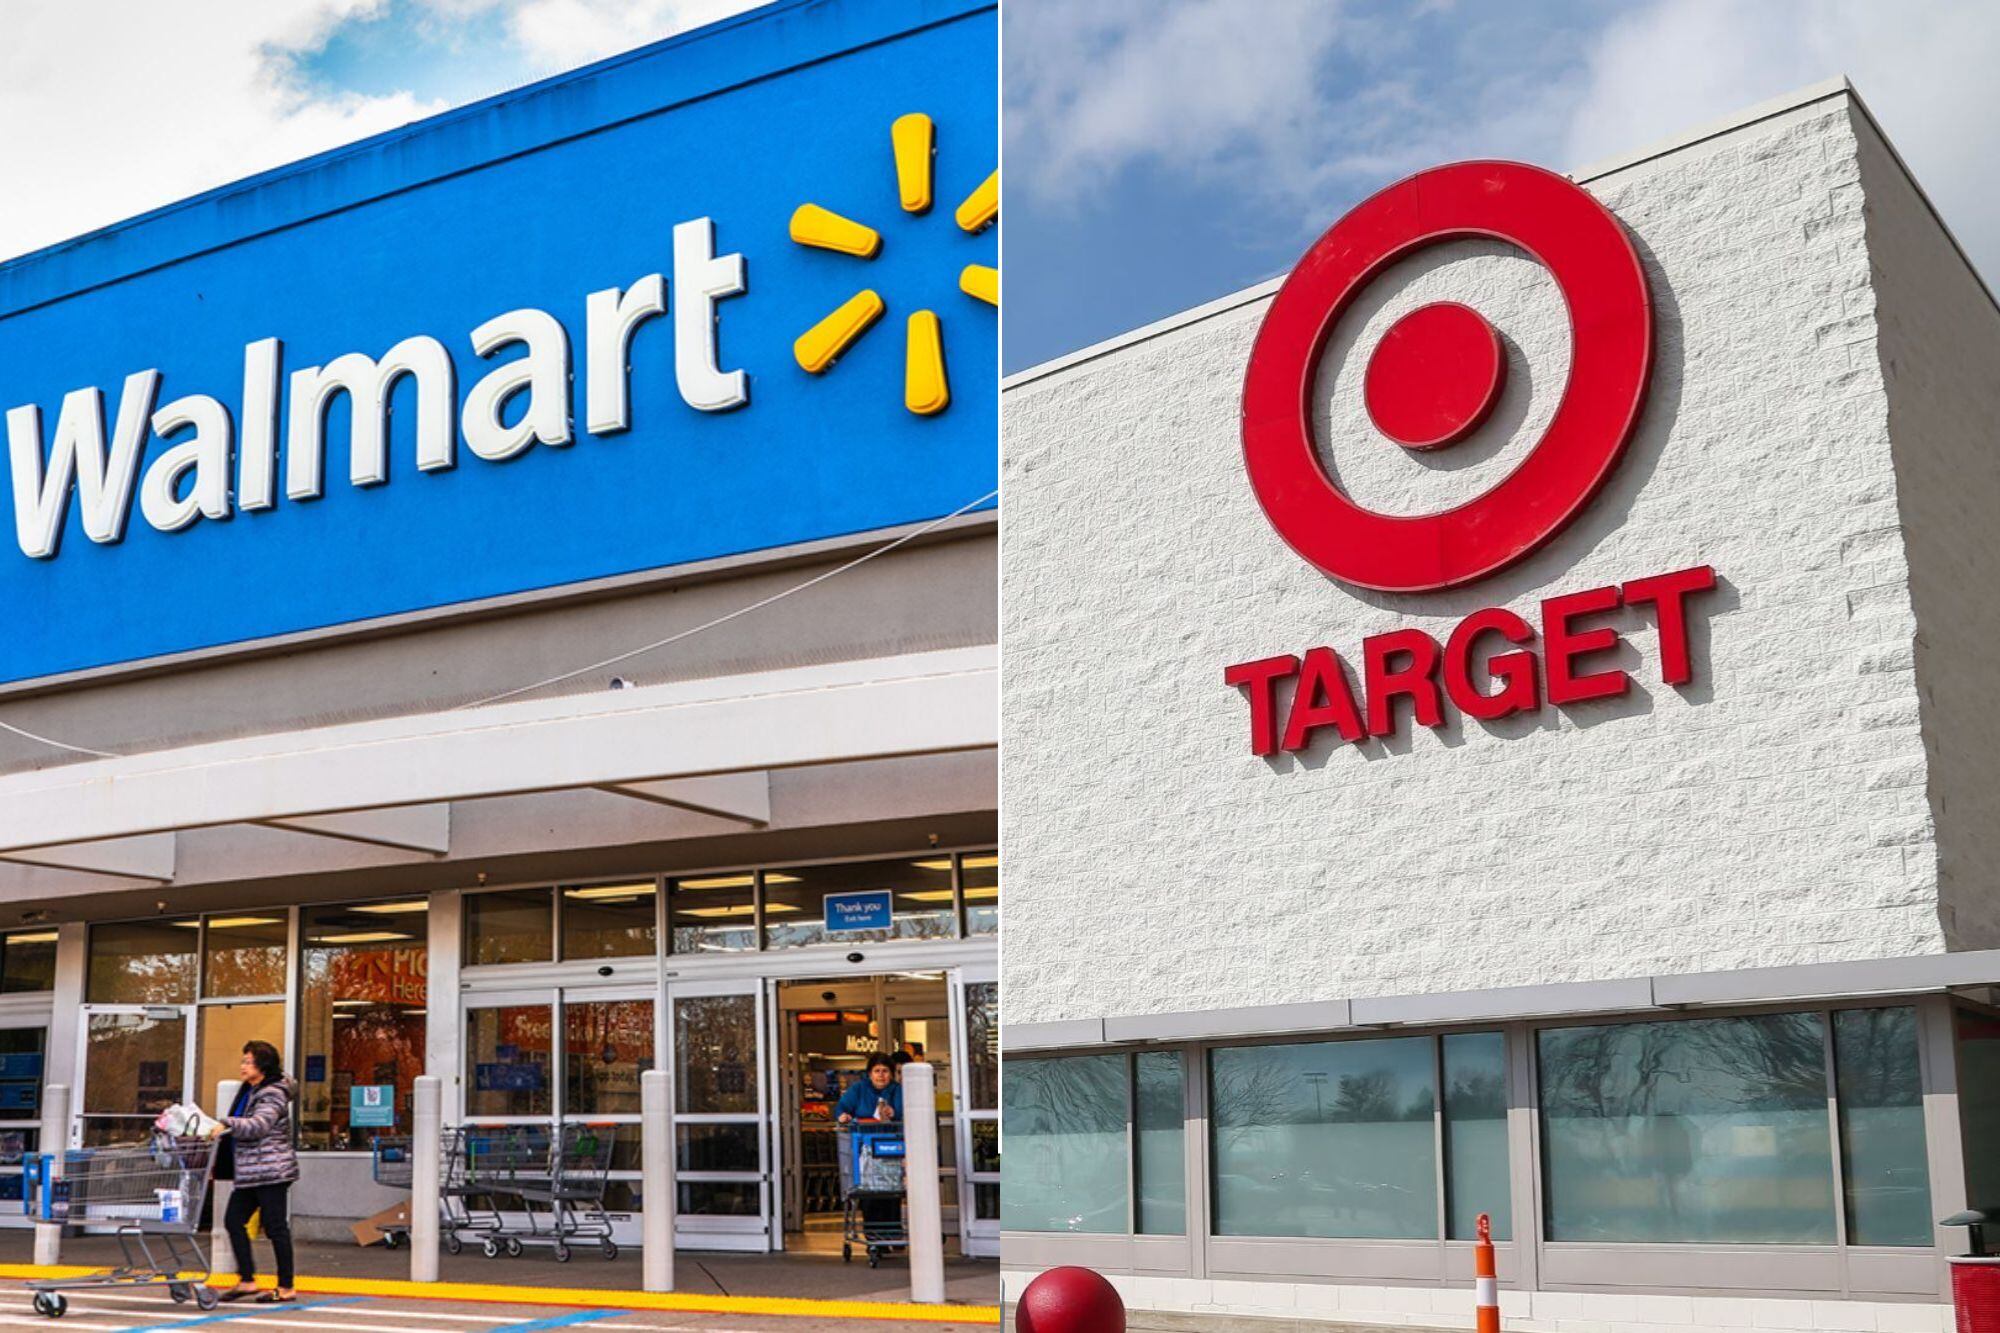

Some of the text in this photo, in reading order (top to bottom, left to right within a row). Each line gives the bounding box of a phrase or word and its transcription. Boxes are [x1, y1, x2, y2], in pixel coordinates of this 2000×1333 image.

[6, 217, 748, 559] Walmart
[1224, 565, 1717, 757] TARGET
[835, 901, 882, 914] Thank you
